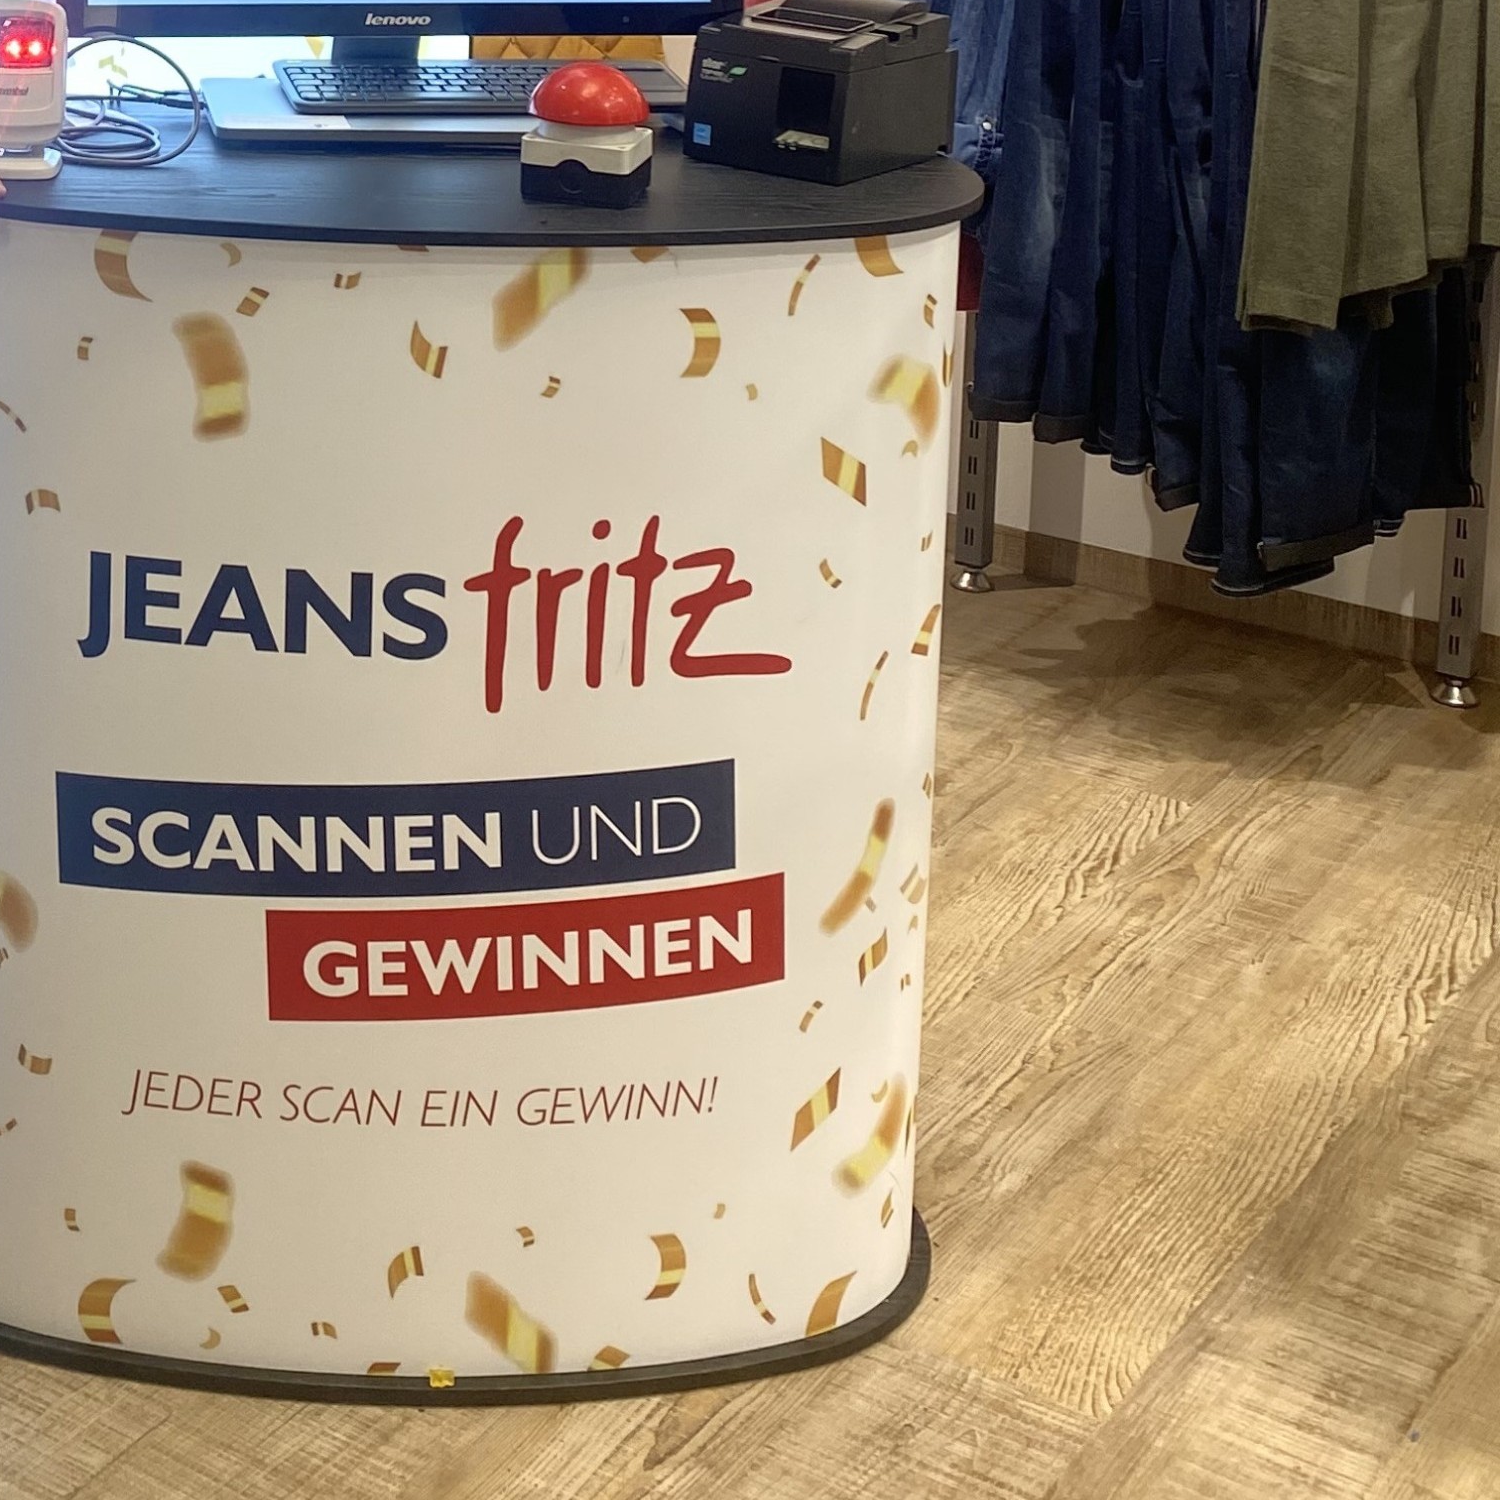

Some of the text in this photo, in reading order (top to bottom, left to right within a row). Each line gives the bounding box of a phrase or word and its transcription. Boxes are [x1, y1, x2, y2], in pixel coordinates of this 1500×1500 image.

[364, 12, 432, 26] lenovo
[90, 796, 702, 874] SCANNEN UND
[302, 908, 753, 999] GEWINNEN
[122, 1068, 719, 1128] JEDER SCAN EIN GEWINN!
